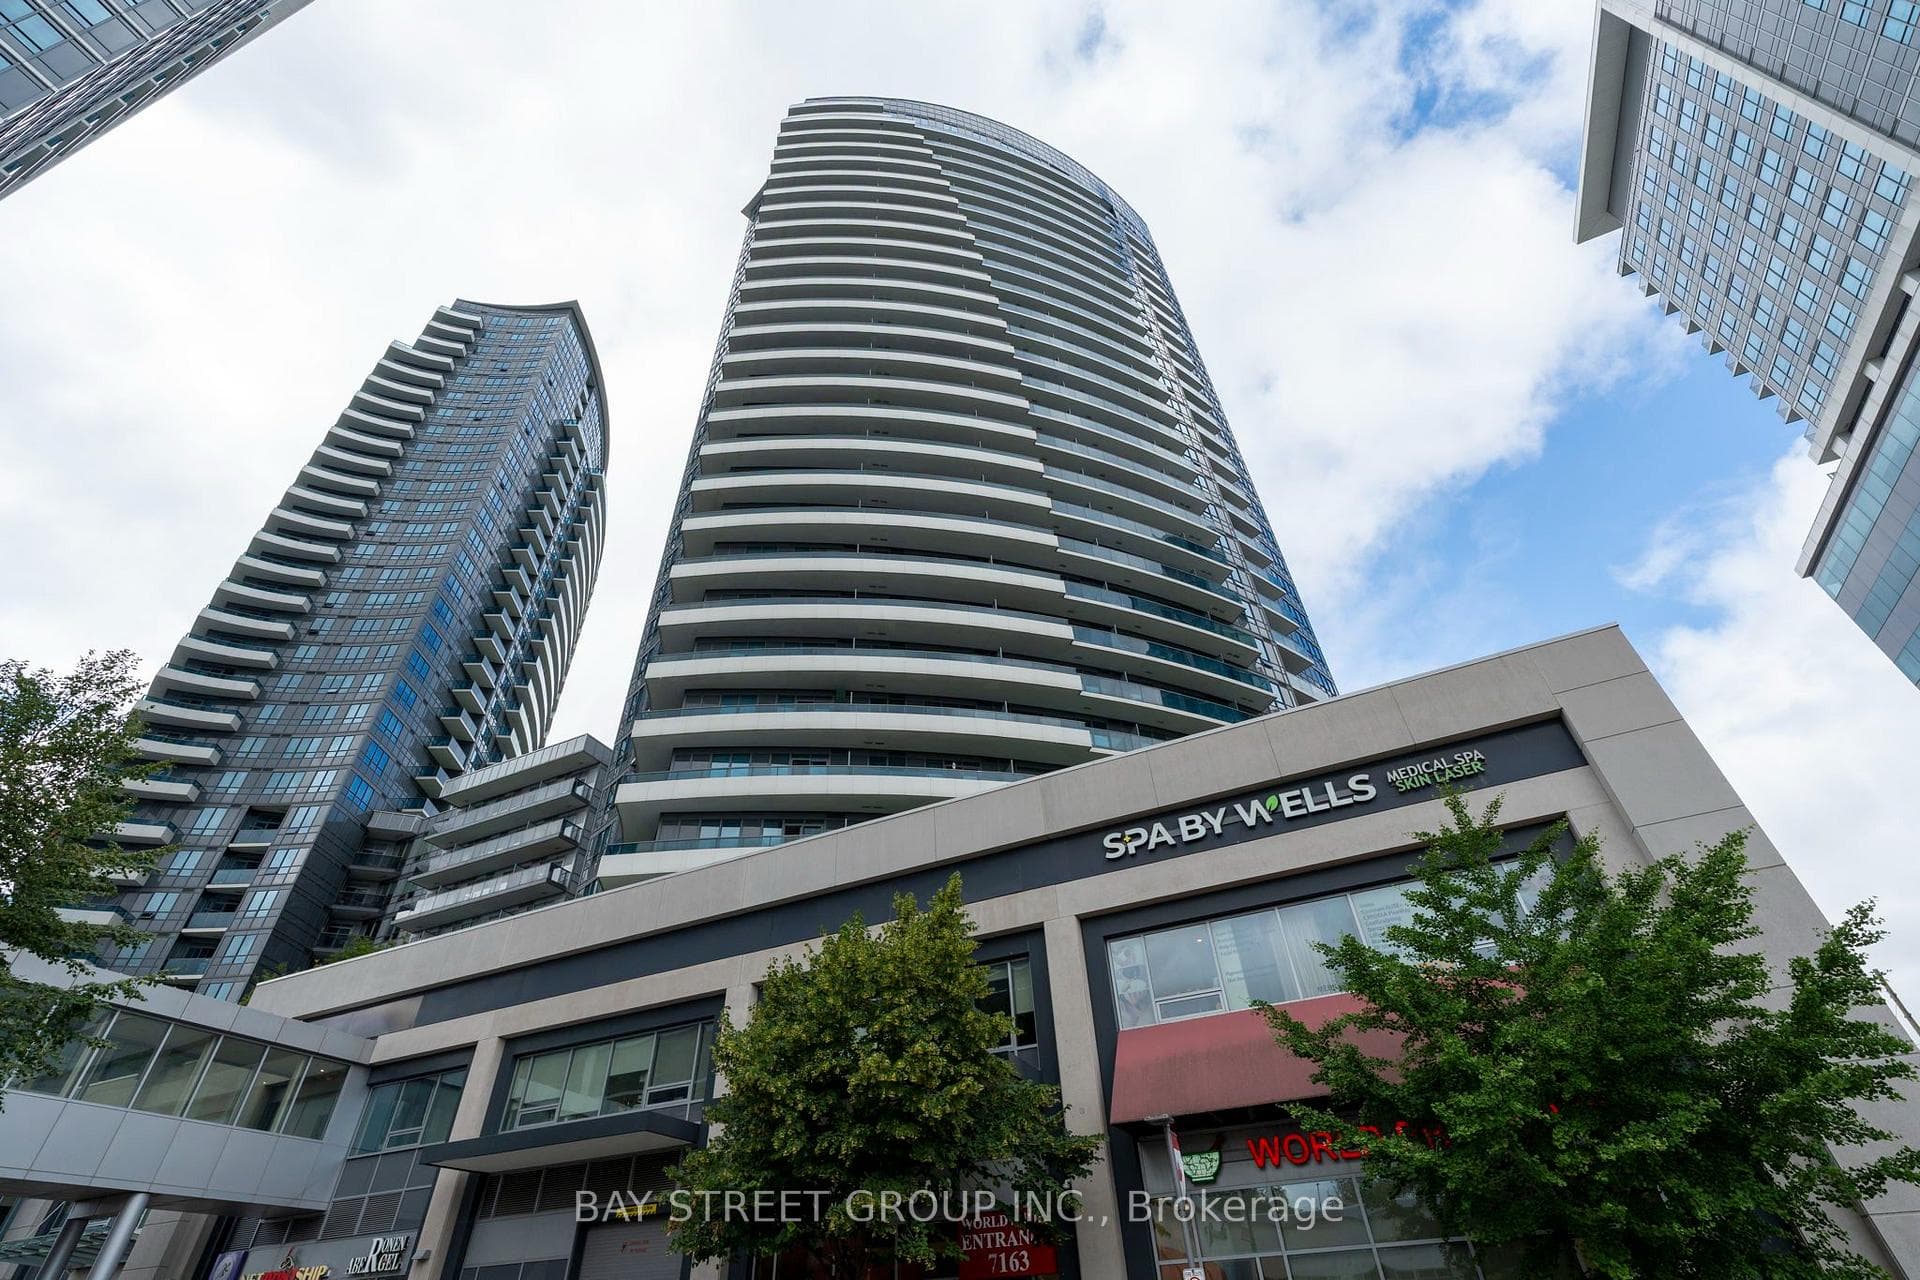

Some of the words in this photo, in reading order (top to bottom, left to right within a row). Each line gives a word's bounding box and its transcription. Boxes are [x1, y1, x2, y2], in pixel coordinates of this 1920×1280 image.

[1387, 758, 1453, 783] MEDICAL
[1454, 749, 1485, 767] SPA
[1396, 772, 1431, 793] SKIN
[1434, 761, 1485, 783] LASER
[1102, 822, 1177, 859] SPA
[1177, 806, 1226, 842] BY
[1233, 773, 1377, 828] WELLS
[962, 1229, 1037, 1251] ENTRAN
[988, 1250, 1030, 1273] 7163
